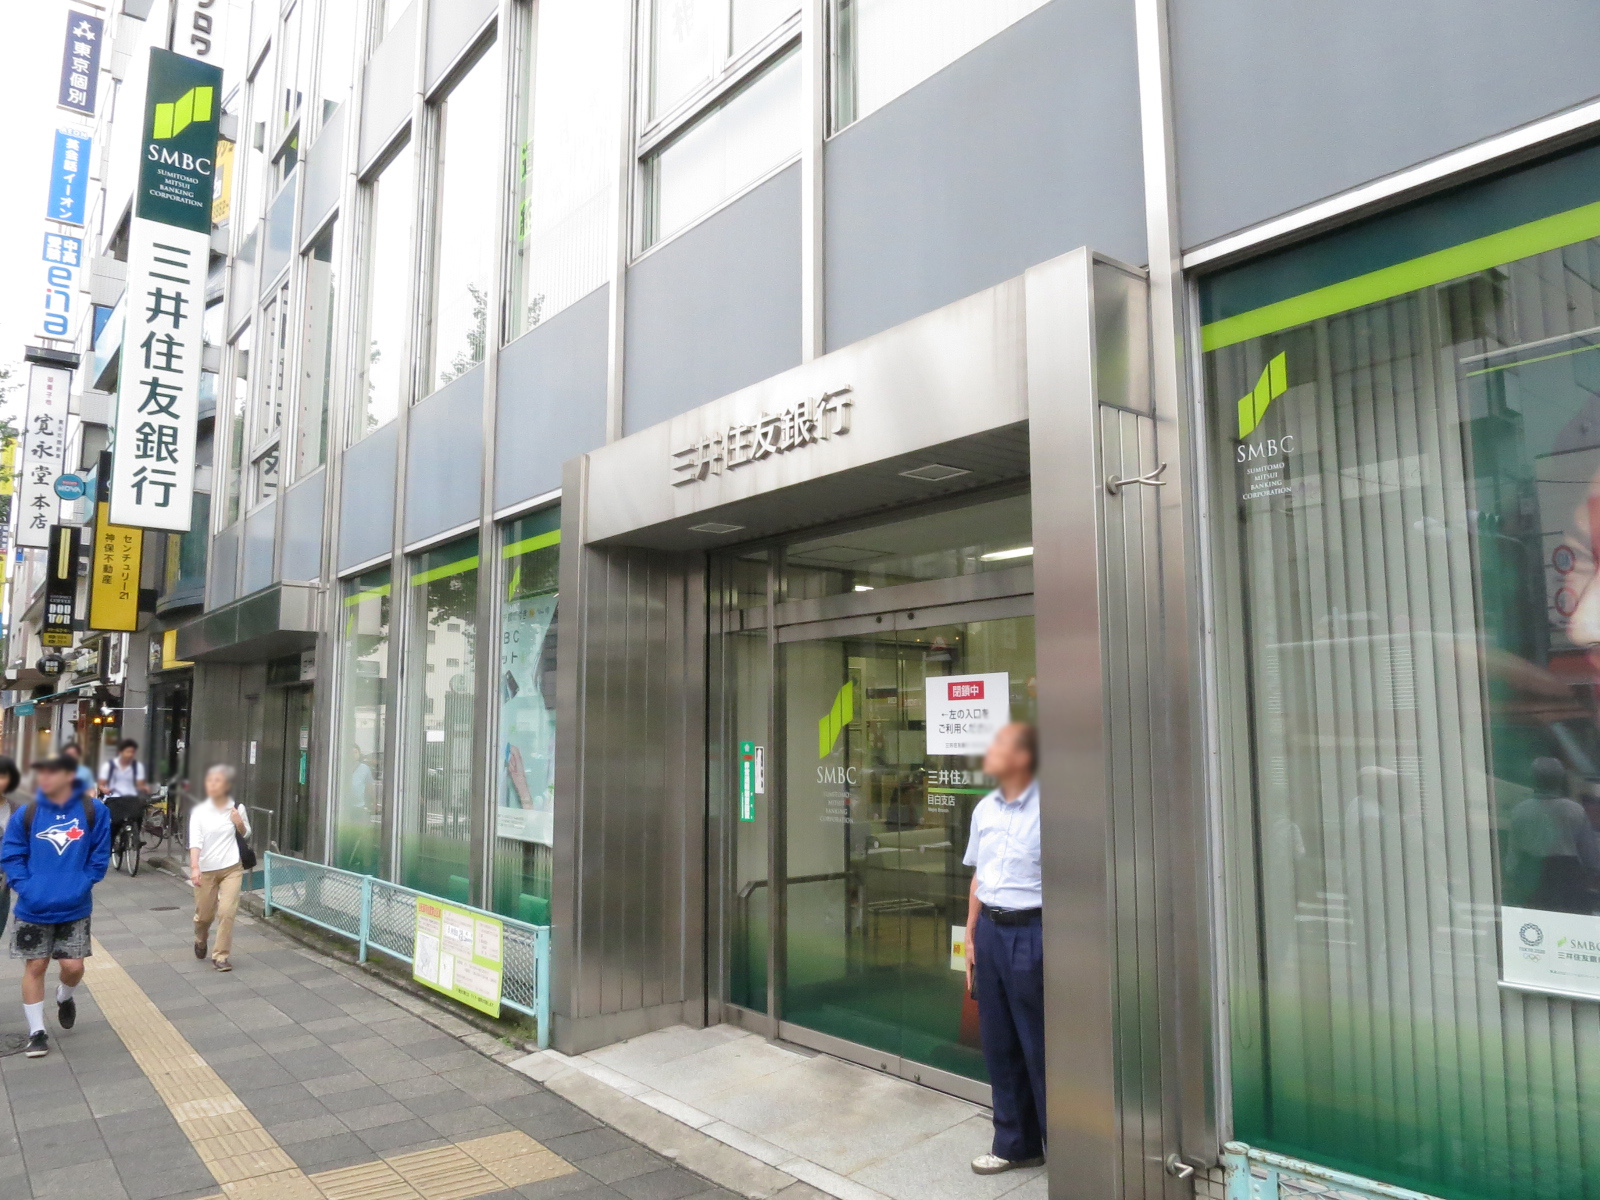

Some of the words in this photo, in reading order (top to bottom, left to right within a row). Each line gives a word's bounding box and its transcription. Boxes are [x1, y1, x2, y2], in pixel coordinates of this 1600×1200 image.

[67, 41, 93, 106] 東京個別
[148, 144, 211, 175] SMBC
[157, 169, 199, 184] SUMITOMO
[165, 179, 191, 190] MITSUI
[149, 189, 204, 208] CORPORATION
[160, 184, 195, 198] BANKING
[131, 242, 191, 507] 三井住友銀行
[671, 384, 854, 488] 三井住友銀行
[1237, 435, 1294, 463] SMBC
[30, 413, 54, 530] 寛永堂本店
[1246, 463, 1285, 474] SUMITOMO
[1254, 472, 1278, 481] MITSUI
[1242, 486, 1292, 500] CORPORATION
[1250, 480, 1283, 491] BANKING
[119, 535, 133, 600] センチュリー21
[952, 685, 980, 698] 閉鎖中
[817, 766, 857, 784] SMBC
[927, 794, 956, 807] 目白支店
